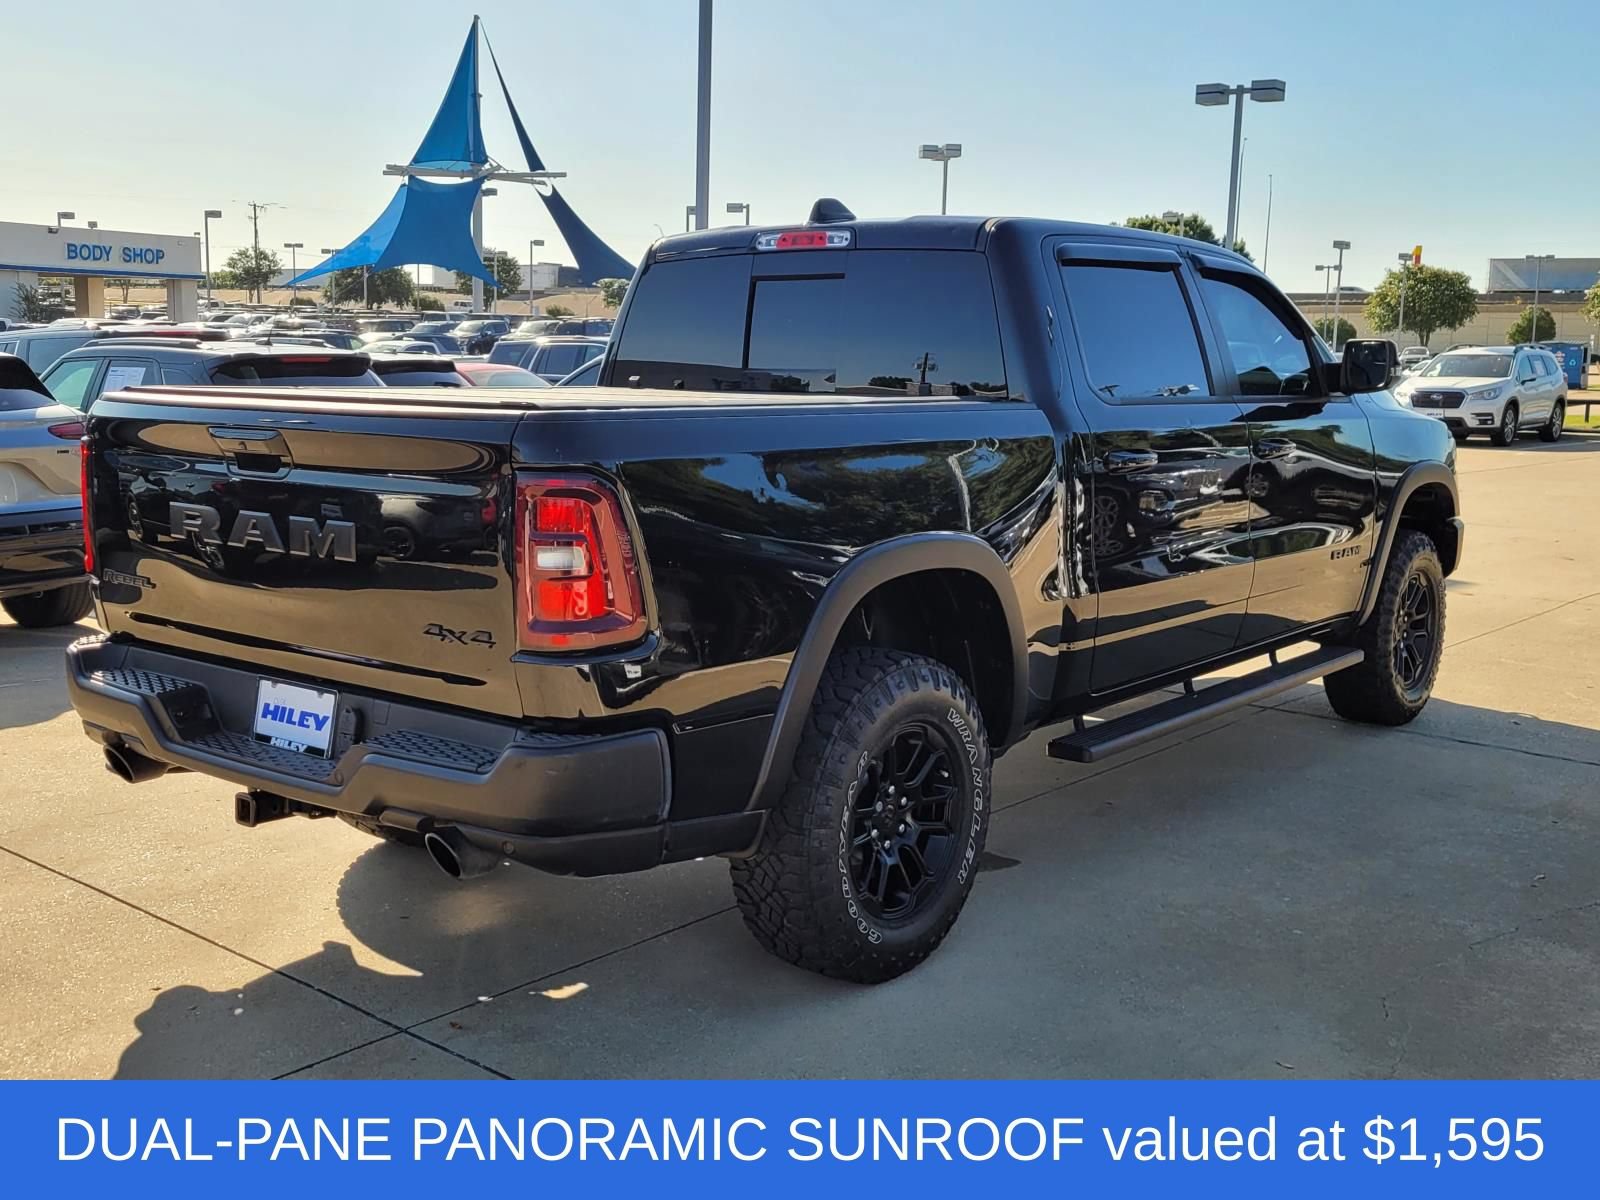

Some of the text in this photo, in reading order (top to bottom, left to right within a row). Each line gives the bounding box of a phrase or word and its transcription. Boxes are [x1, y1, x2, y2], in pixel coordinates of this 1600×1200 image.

[66, 242, 165, 265] BODY SHOP
[169, 501, 357, 562] RAM
[1330, 544, 1361, 561] RAM
[103, 568, 156, 590] REBEL
[261, 702, 330, 732] HILEY
[270, 736, 309, 753] HILEY
[947, 708, 983, 884] WRANGLER
[837, 751, 882, 944] GOODYEAR
